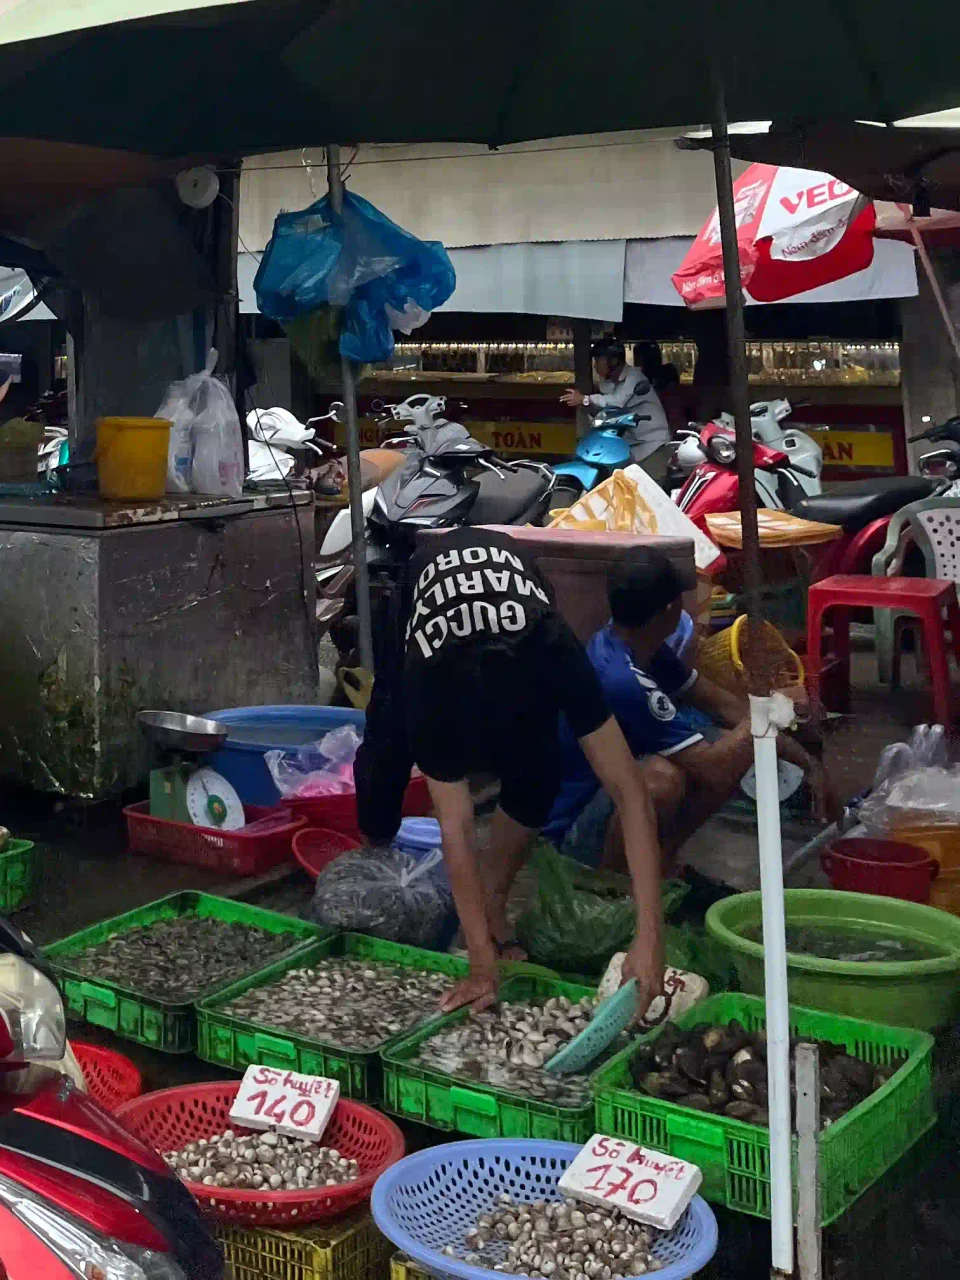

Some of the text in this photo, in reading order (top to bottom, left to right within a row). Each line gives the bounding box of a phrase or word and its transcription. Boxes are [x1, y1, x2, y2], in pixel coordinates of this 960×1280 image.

[414, 600, 527, 659] GUCCI
[247, 1090, 316, 1127] 140
[584, 1164, 658, 1205] 170
